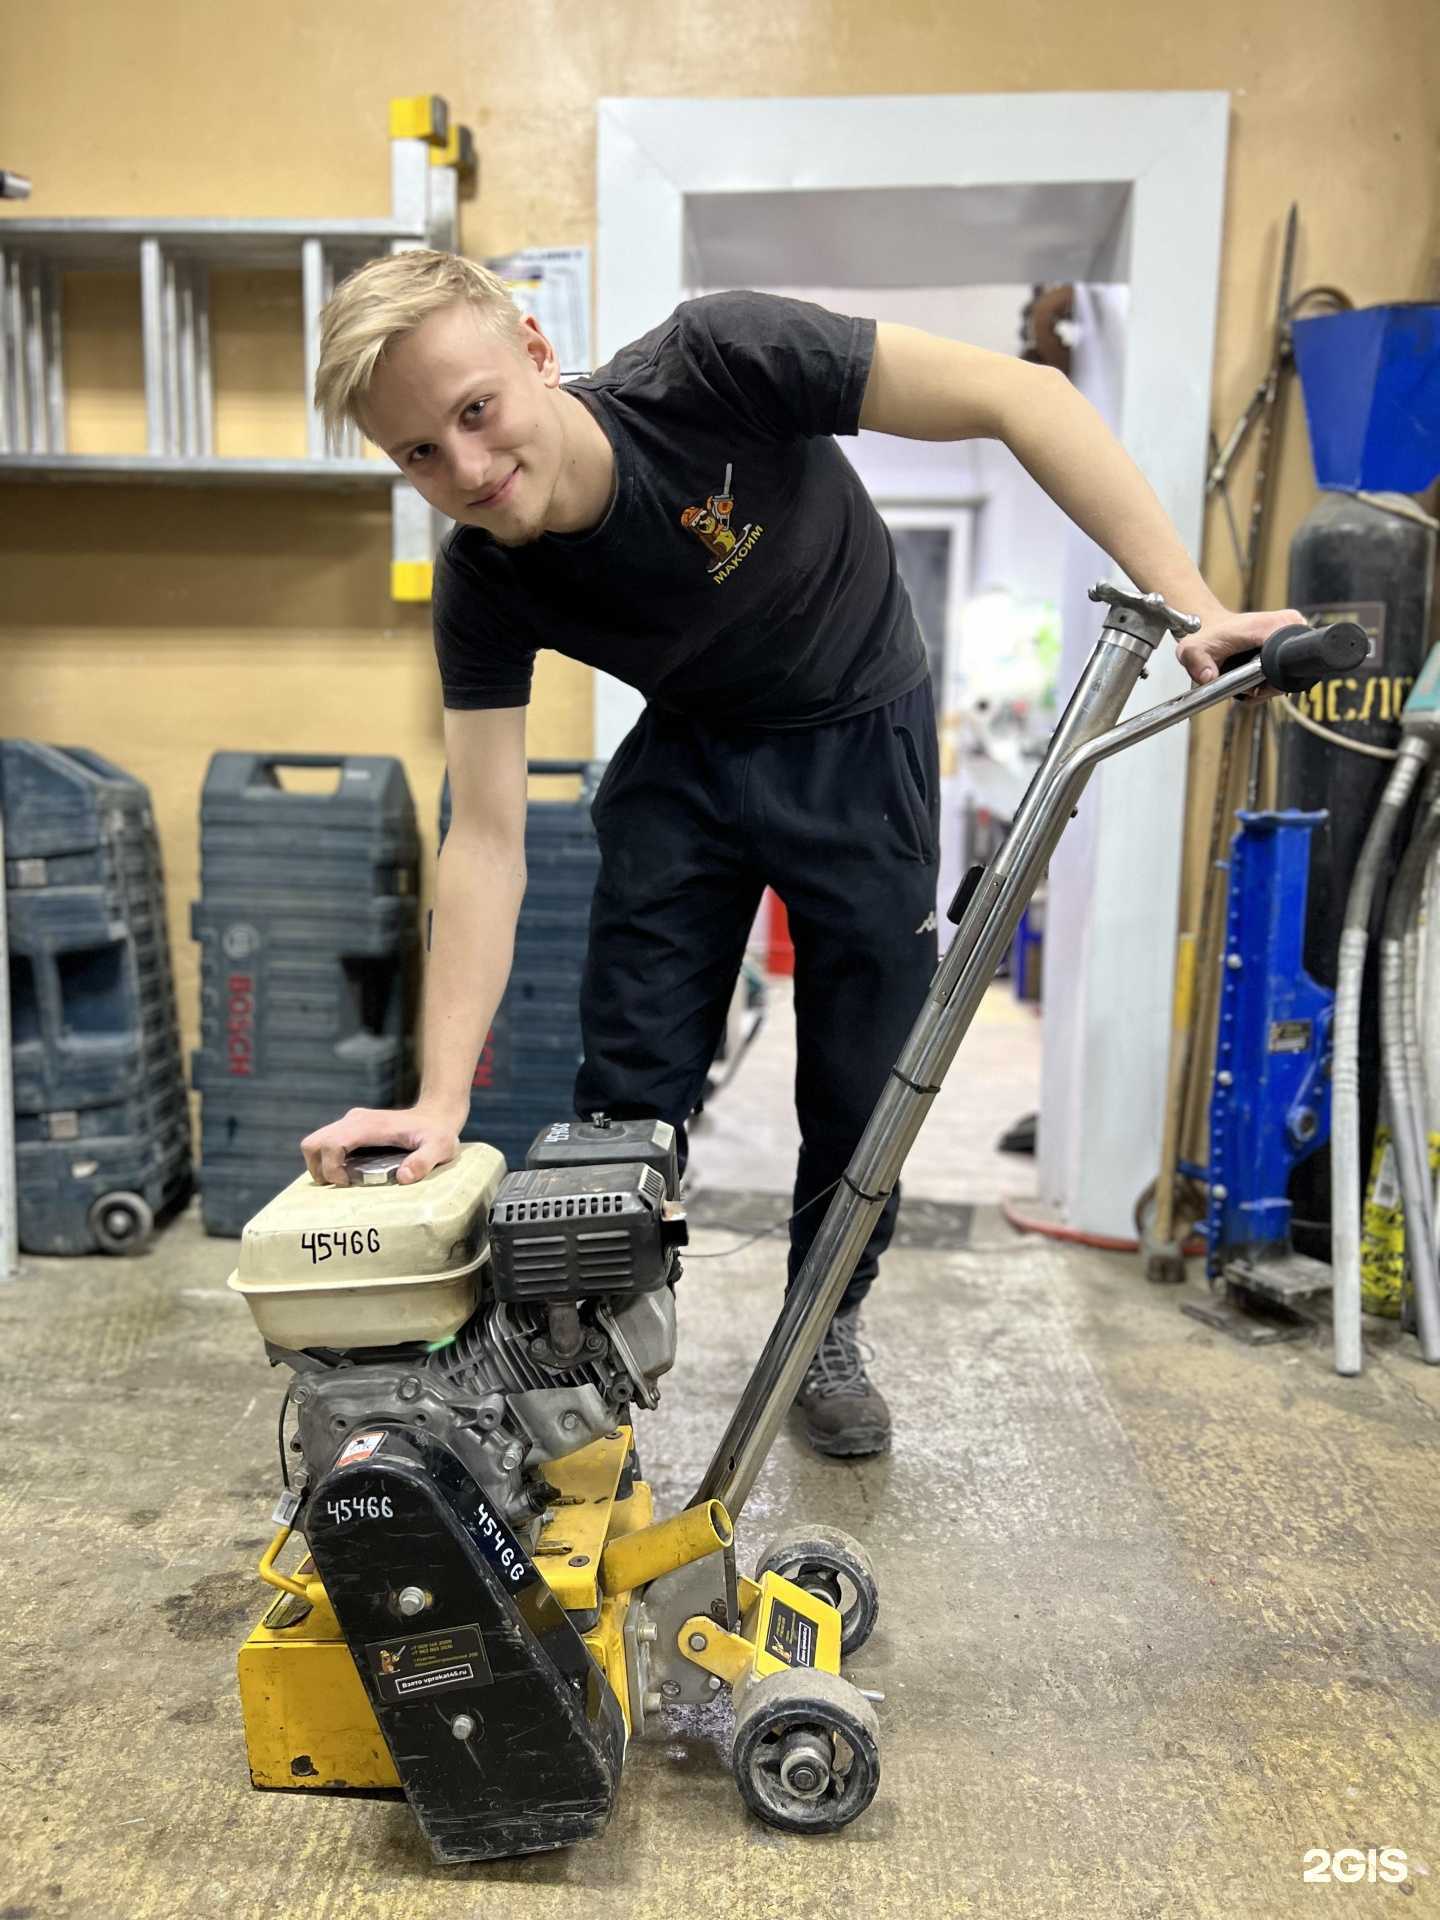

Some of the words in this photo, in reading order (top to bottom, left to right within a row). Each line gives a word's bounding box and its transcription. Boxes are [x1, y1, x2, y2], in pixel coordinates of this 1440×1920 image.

[227, 975, 254, 1076] BOSCH
[301, 1228, 380, 1264] 45466
[327, 1496, 394, 1525] 45466
[478, 1503, 525, 1581] 45466
